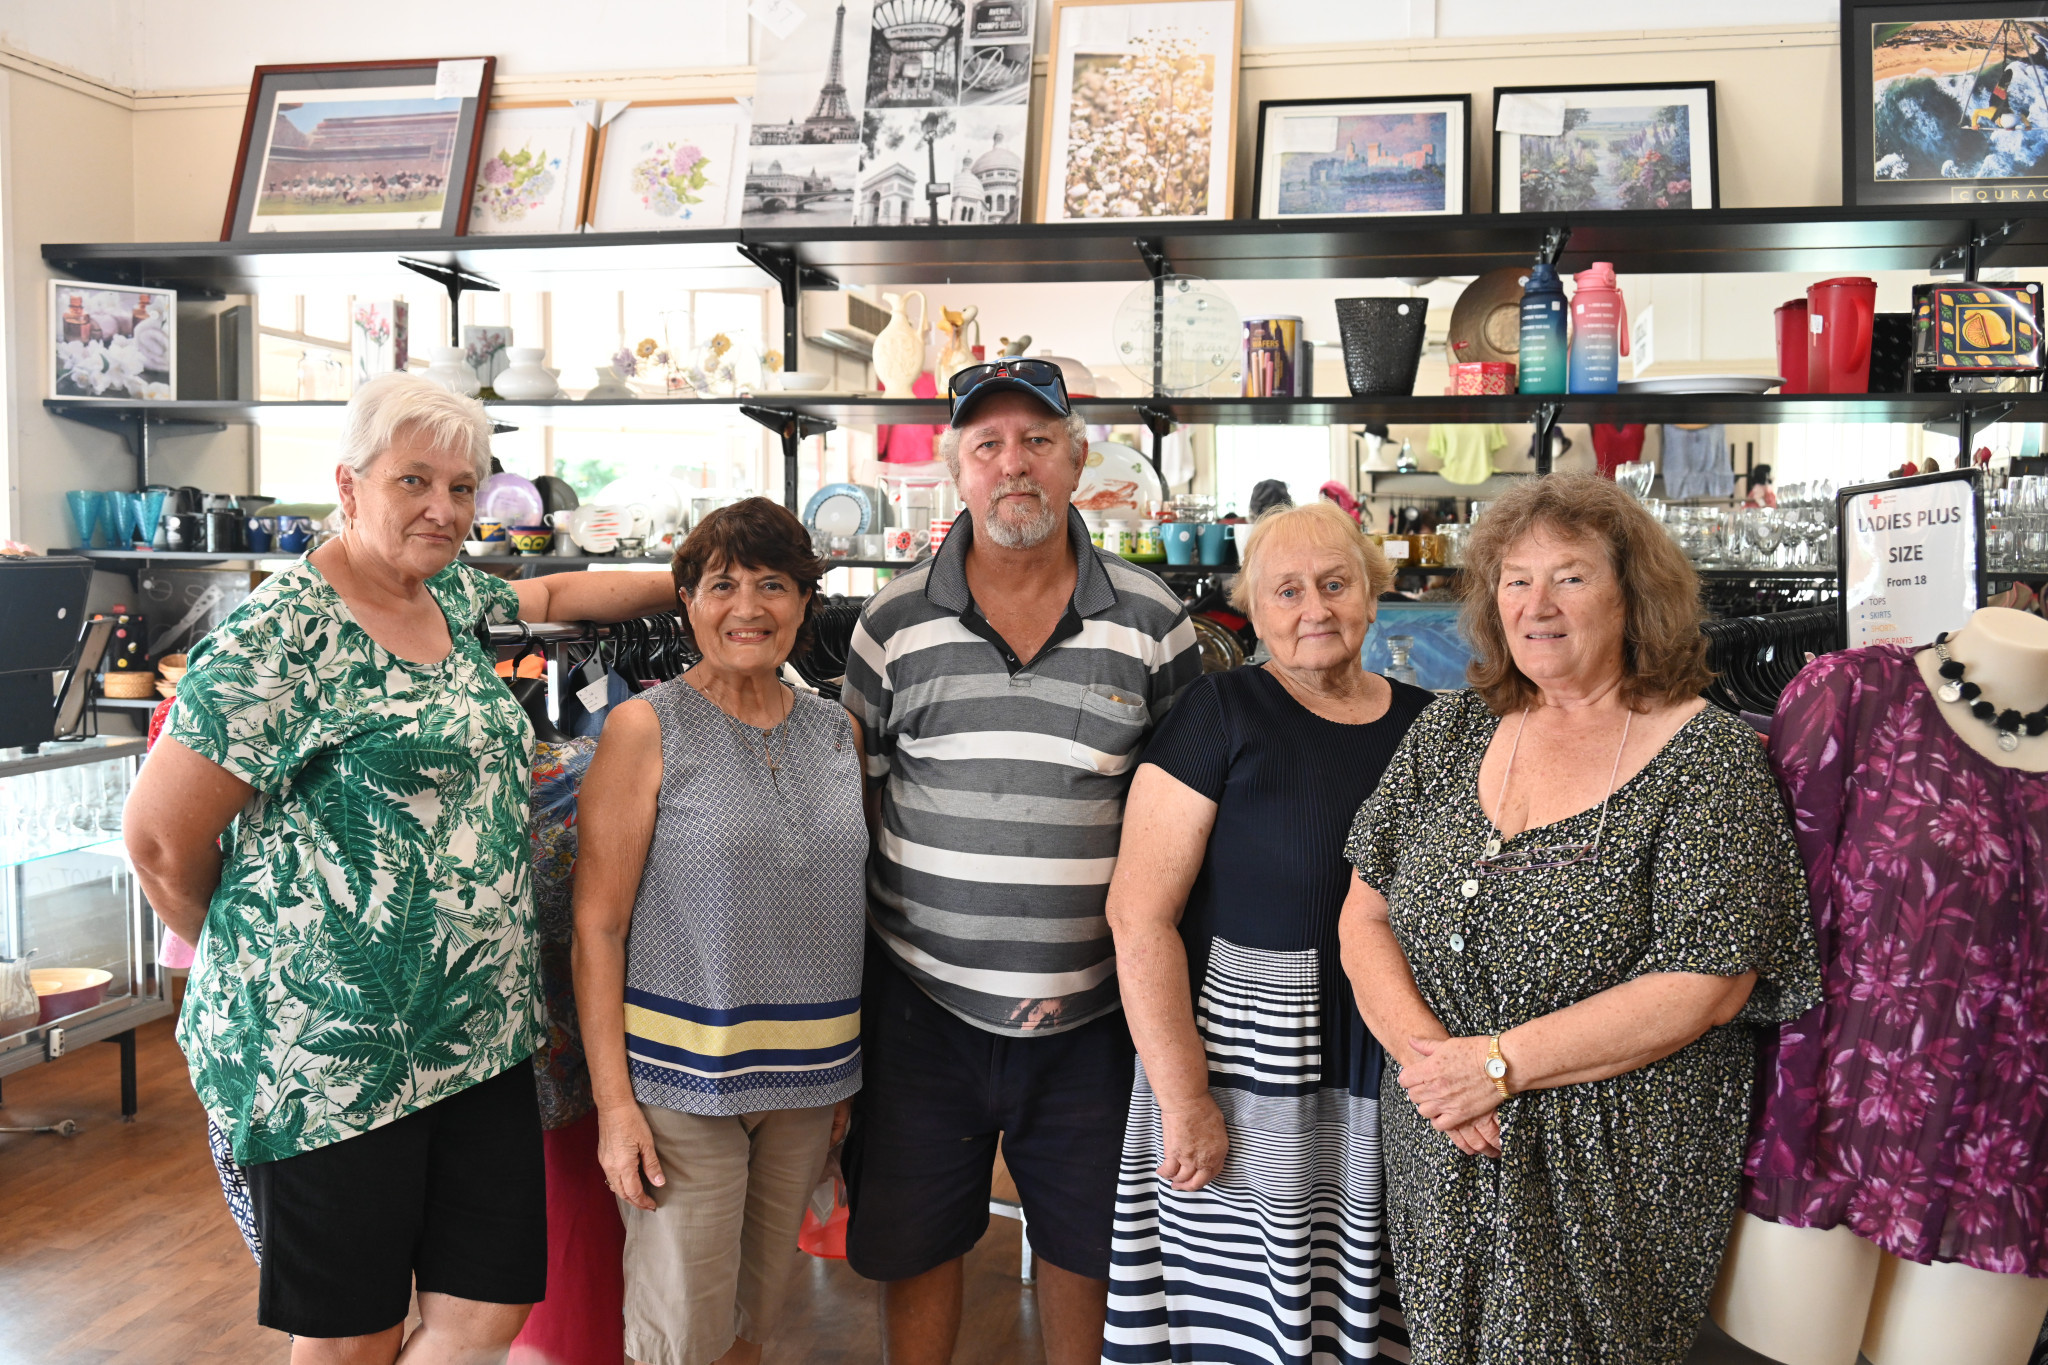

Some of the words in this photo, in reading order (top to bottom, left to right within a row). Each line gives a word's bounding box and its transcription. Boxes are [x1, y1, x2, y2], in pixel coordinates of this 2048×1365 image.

[988, 7, 1012, 16] AVENUE
[1252, 340, 1279, 348] WAFERS
[1858, 512, 1912, 533] LADIES
[1917, 506, 1961, 527] PLUS
[1888, 544, 1924, 563] SIZE
[1887, 577, 1912, 587] From
[1914, 575, 1927, 585] 18
[1869, 597, 1887, 606] TOPS
[1869, 610, 1892, 619] SKIRTS
[1871, 623, 1897, 633] SHORTS
[1871, 638, 1890, 646] LONG
[1891, 636, 1913, 645] PANTS
